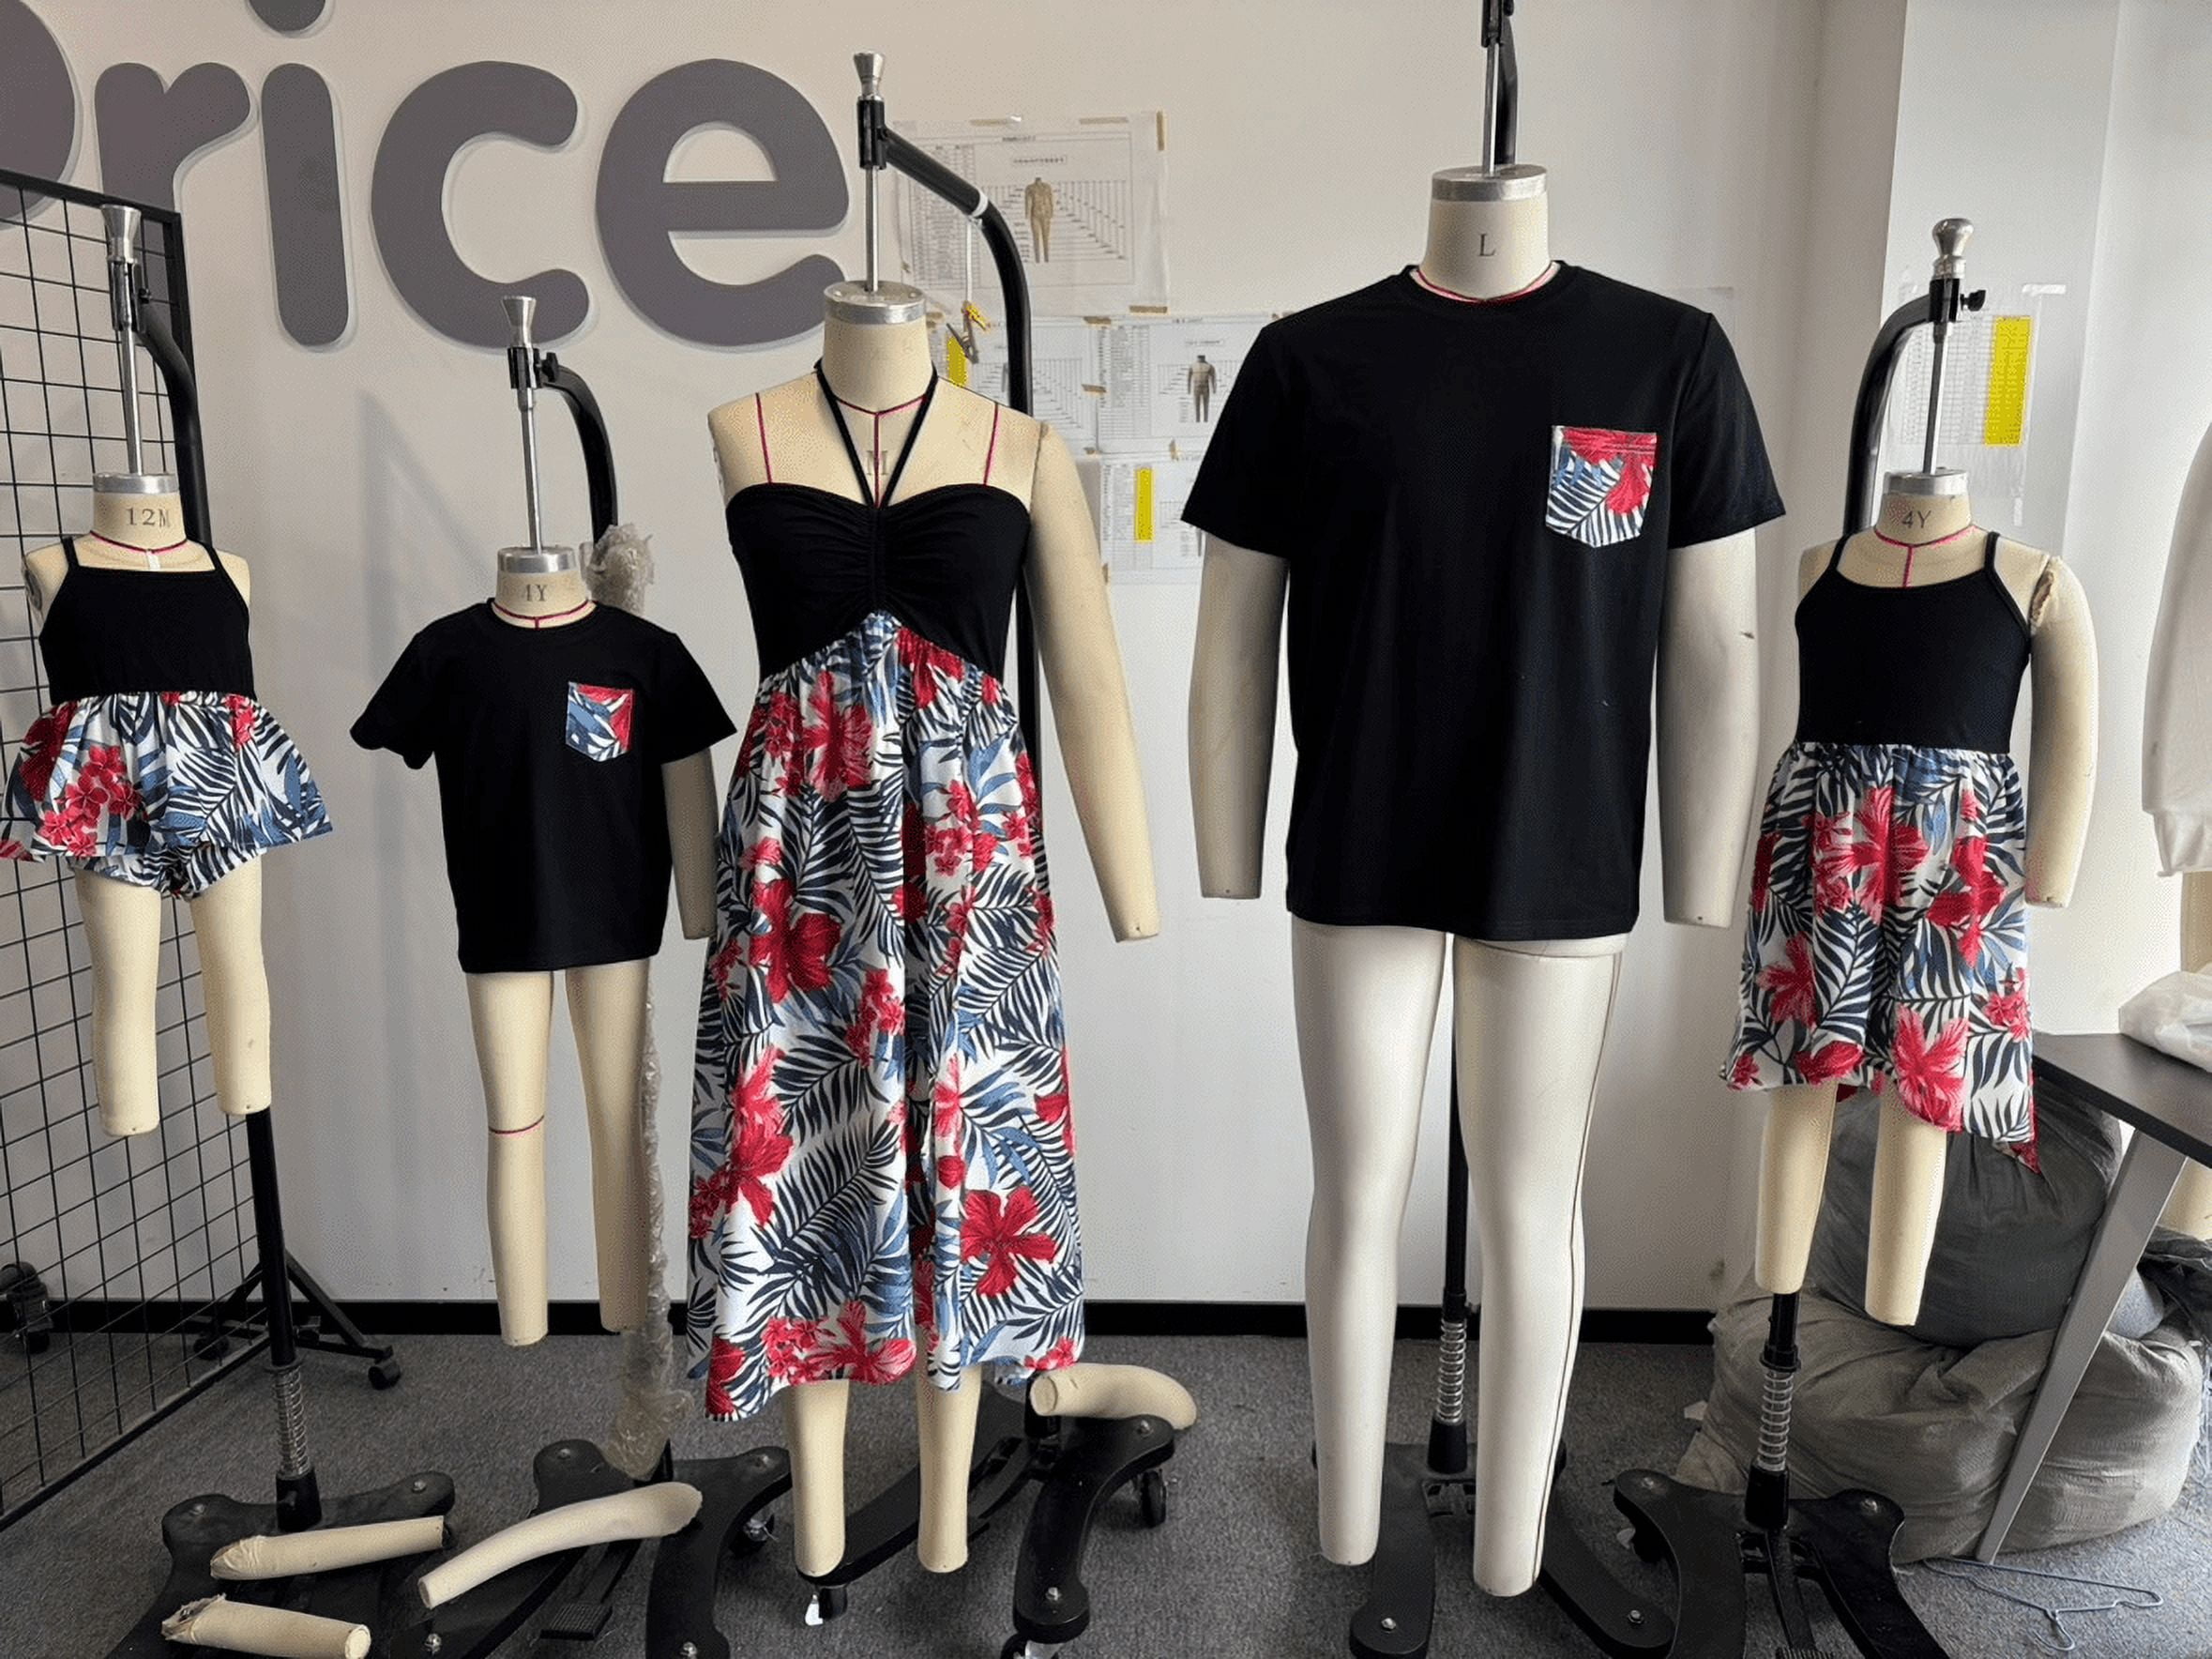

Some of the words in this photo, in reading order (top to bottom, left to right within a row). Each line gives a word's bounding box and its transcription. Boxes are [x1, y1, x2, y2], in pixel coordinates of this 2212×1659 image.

[1478, 233, 1496, 257] L
[127, 507, 170, 527] 12M
[1901, 510, 1932, 529] 4Y
